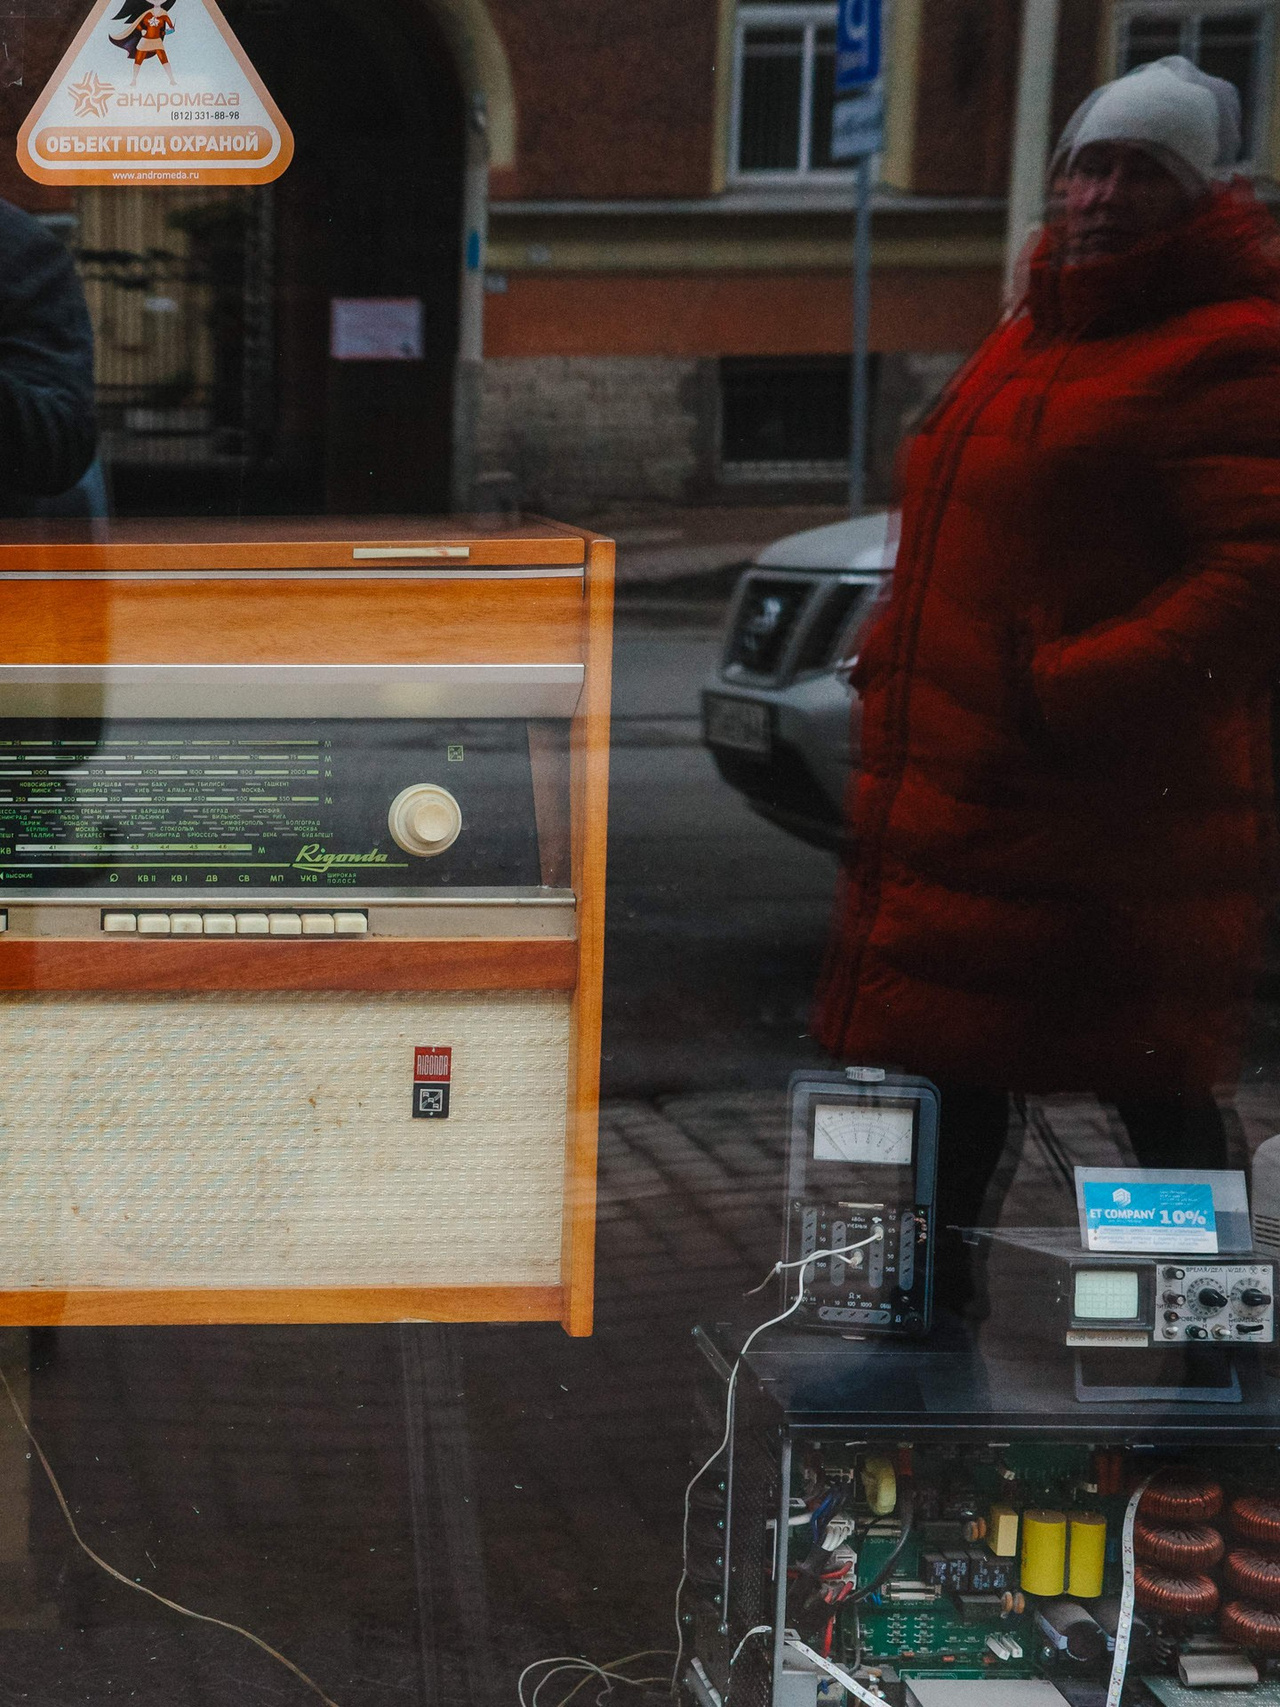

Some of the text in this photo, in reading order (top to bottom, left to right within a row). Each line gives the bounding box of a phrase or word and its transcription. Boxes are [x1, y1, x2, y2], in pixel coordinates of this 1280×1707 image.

[170, 111, 240, 121] (812) 331-88-98
[46, 131, 259, 155] ОБЪЕКТ ПОД ОХРАНОЙ
[112, 170, 200, 180] www.andromeda.ru
[295, 843, 388, 872] Rigonda
[138, 874, 149, 882] КВ
[171, 874, 182, 882] КВ
[205, 874, 218, 882] ДВ
[238, 874, 250, 882] СВ
[270, 874, 284, 882] МП
[417, 1054, 449, 1076] RIGONDA
[1089, 1208, 1101, 1219] ET
